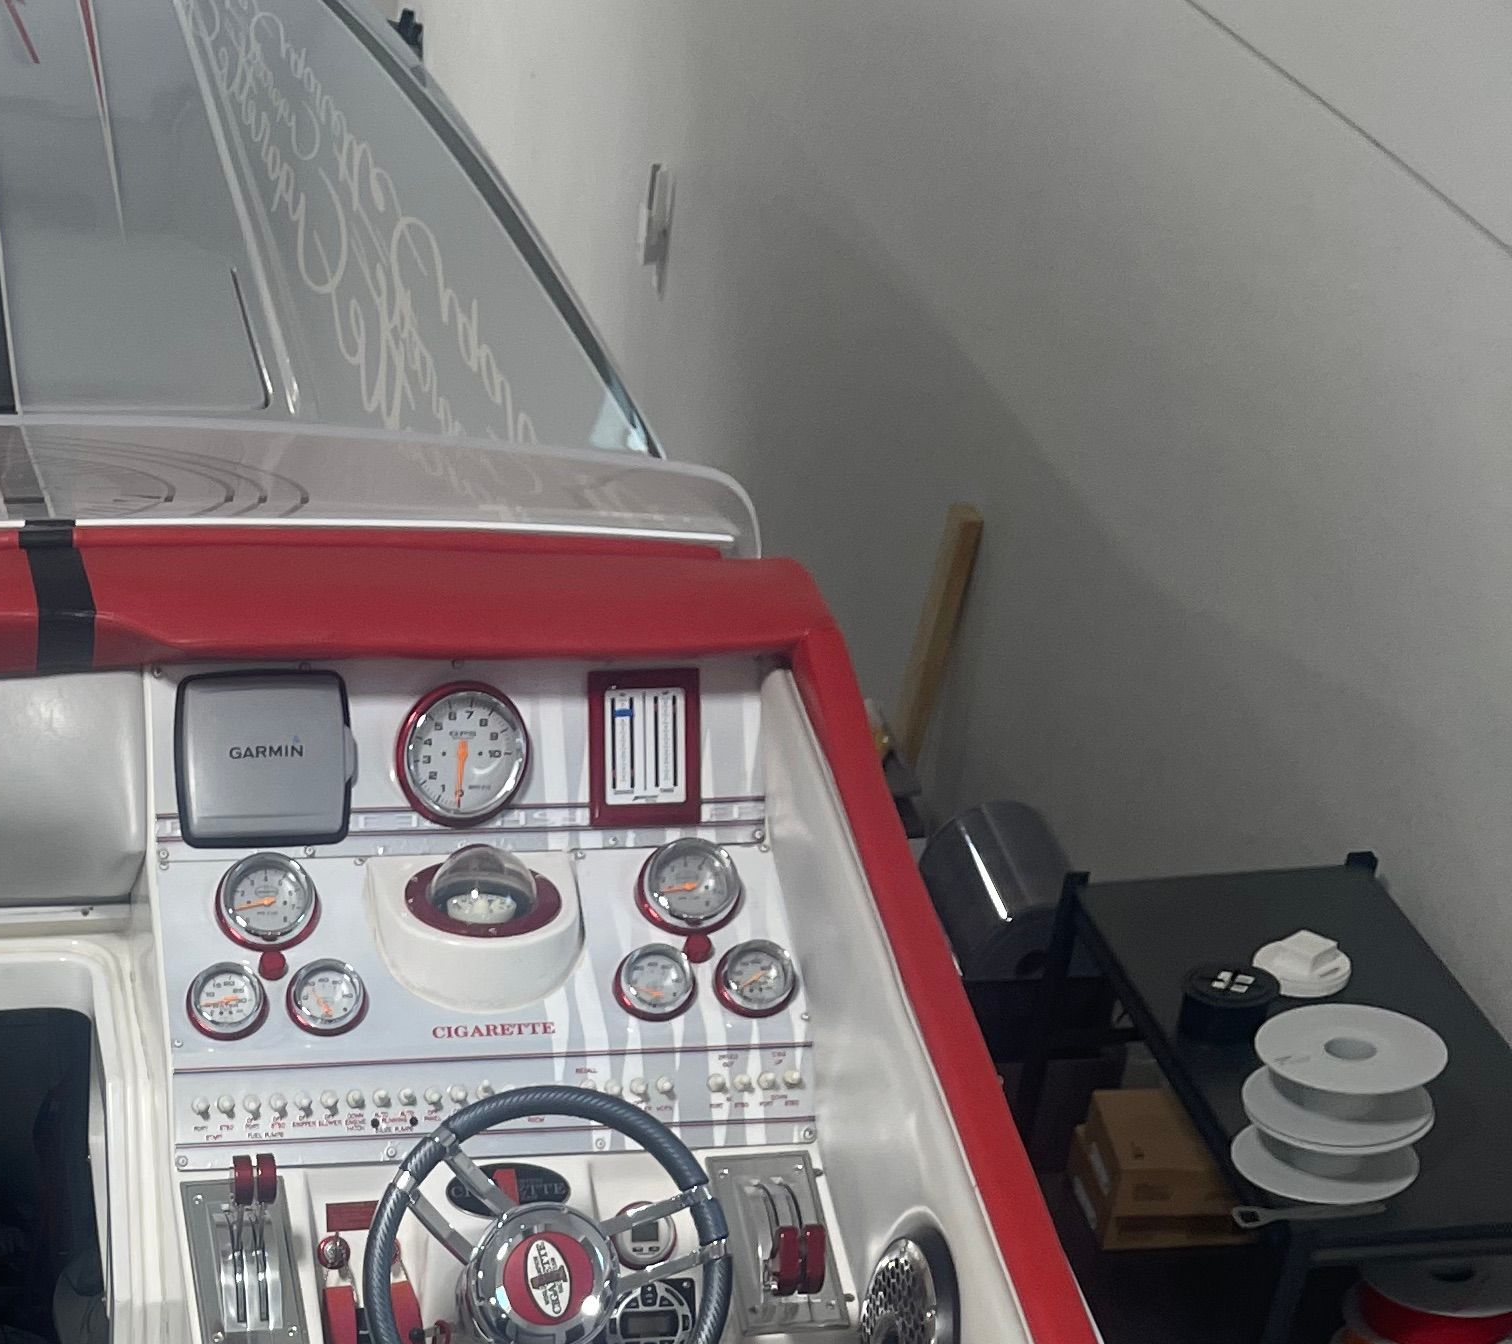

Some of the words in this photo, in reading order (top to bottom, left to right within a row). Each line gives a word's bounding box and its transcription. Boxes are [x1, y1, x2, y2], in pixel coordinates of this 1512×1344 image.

[448, 712, 457, 721] 6
[465, 711, 474, 720] 7
[434, 722, 443, 730] 5
[479, 718, 489, 727] 8
[490, 732, 498, 740] 9
[424, 738, 433, 747] 4
[229, 743, 304, 760] GARMIN
[488, 749, 502, 758] 10
[422, 755, 431, 764] 3
[429, 771, 437, 780] 2
[431, 1020, 556, 1039] CIGARETTE
[535, 1241, 563, 1315] CIGAETTE
